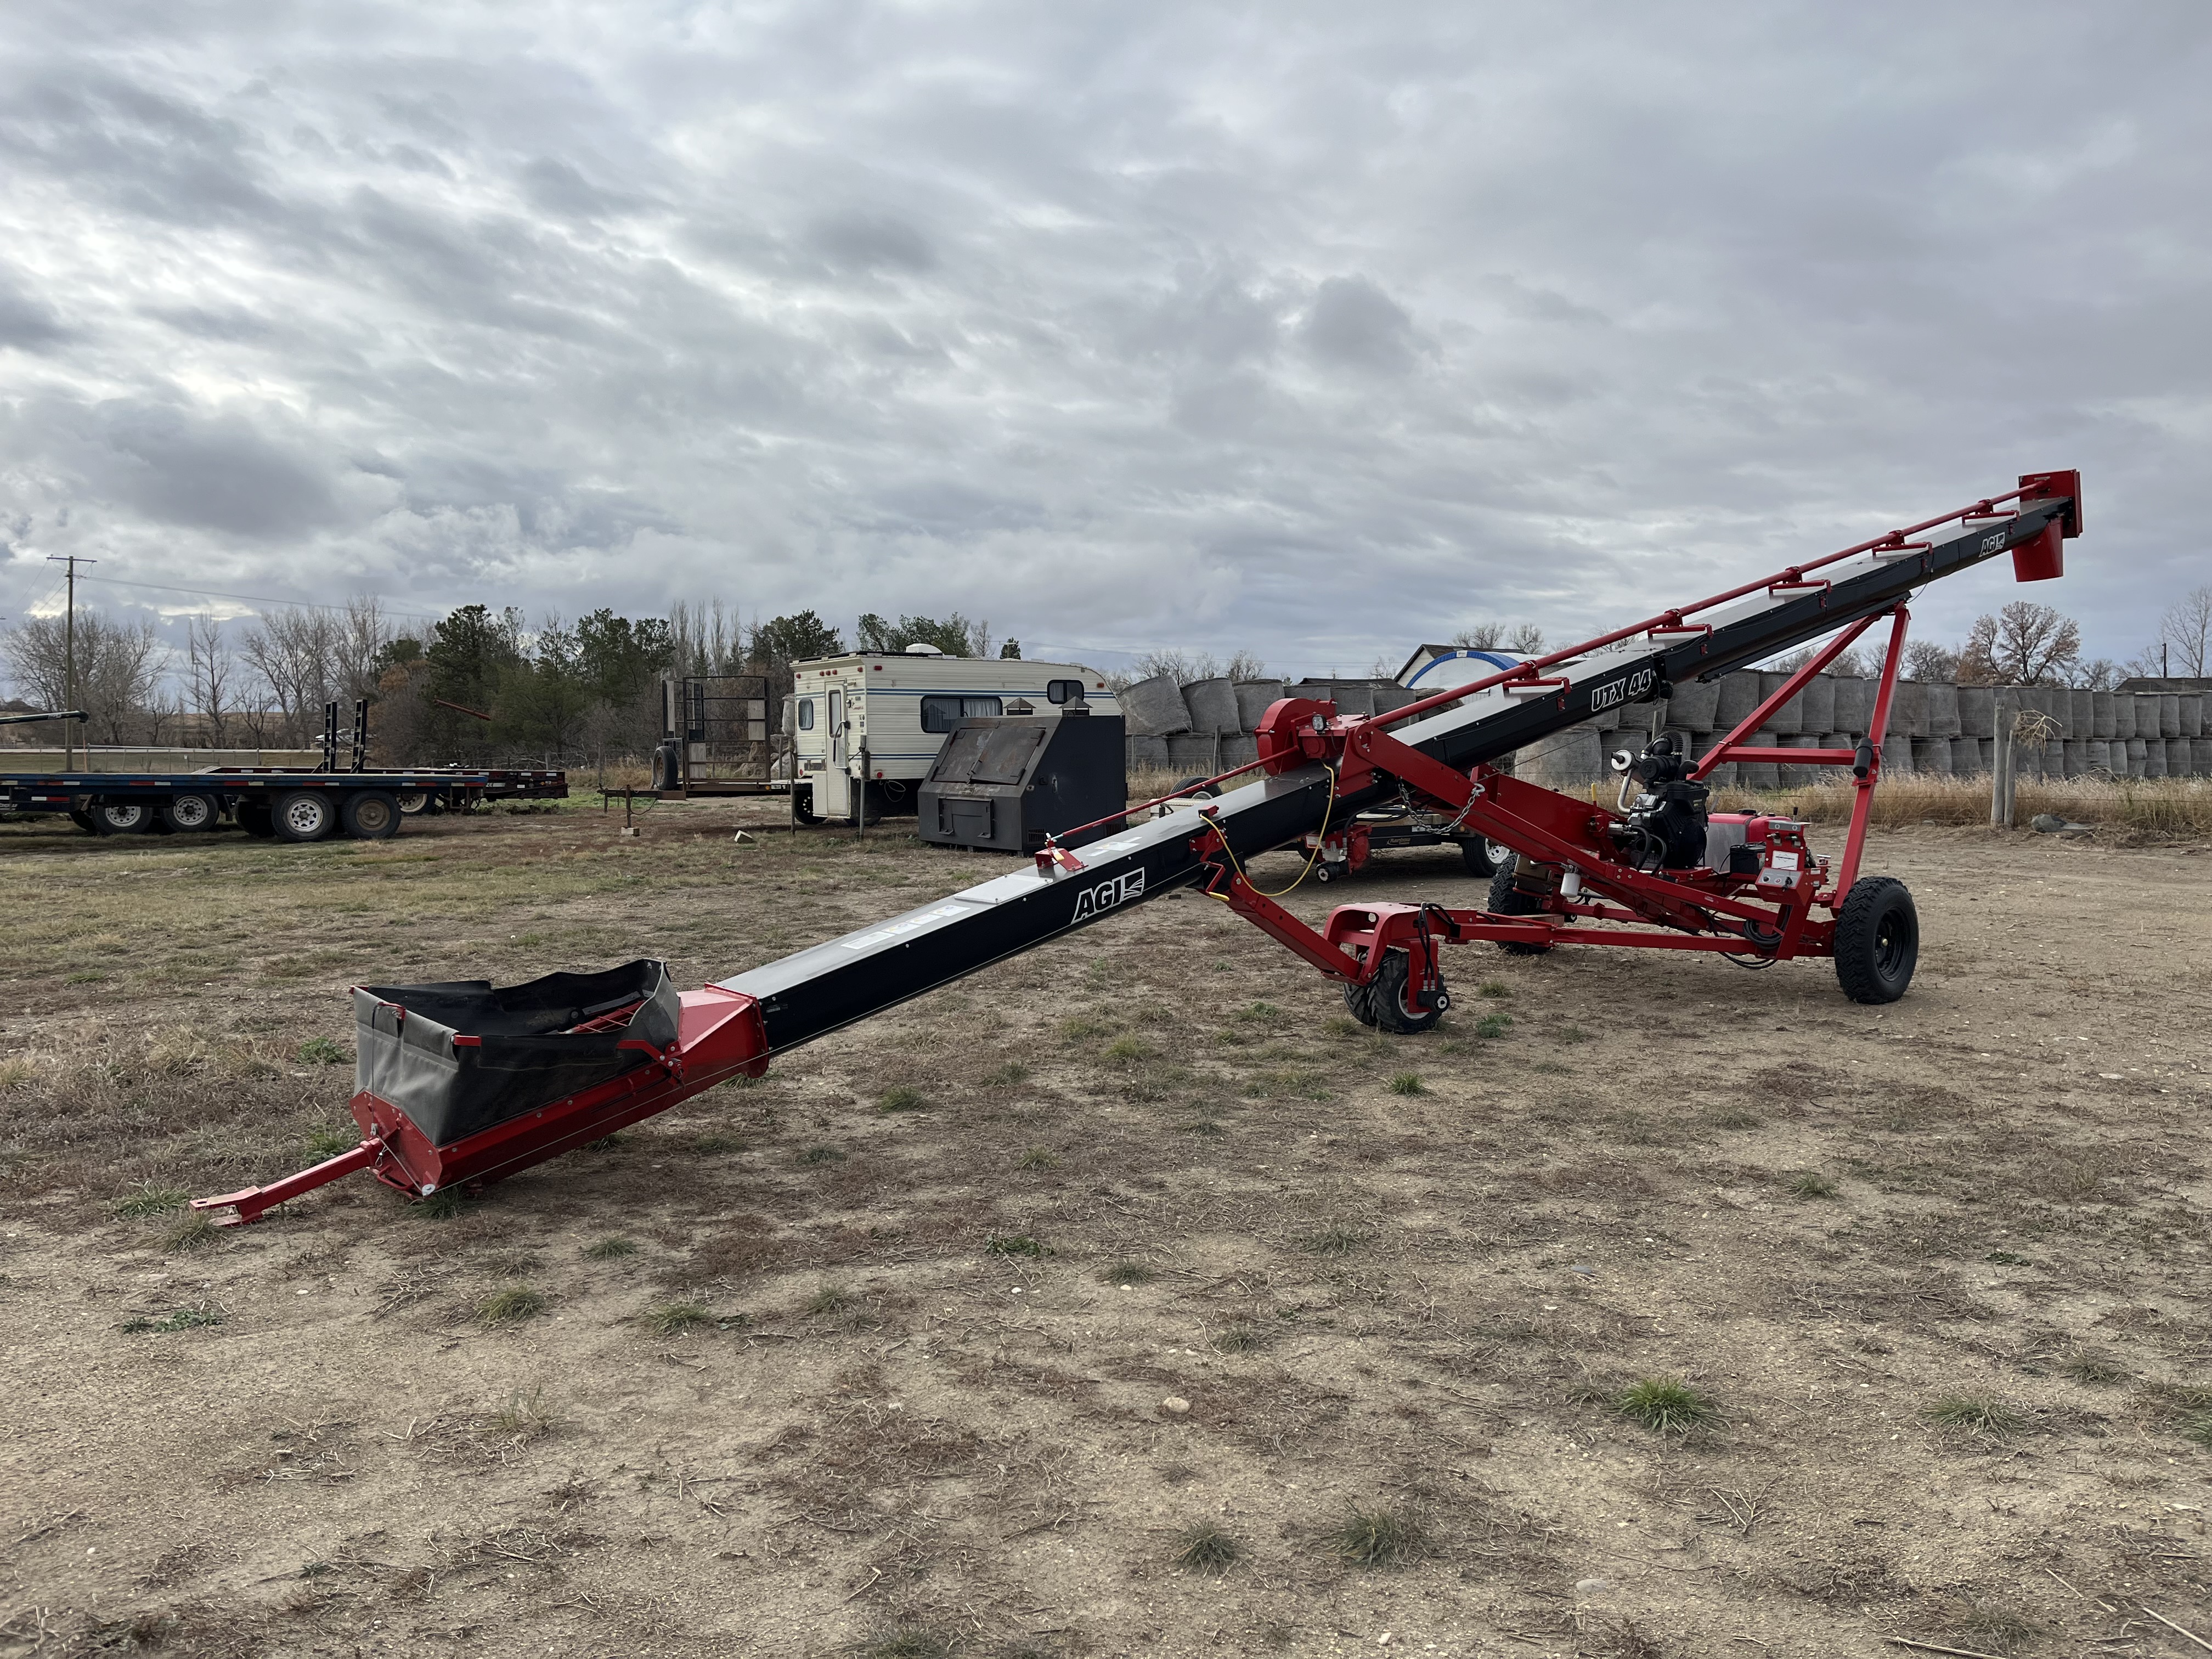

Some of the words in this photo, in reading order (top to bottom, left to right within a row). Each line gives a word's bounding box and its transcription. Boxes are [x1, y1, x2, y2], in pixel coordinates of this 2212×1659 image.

[1978, 535, 1997, 558] AGI
[1592, 678, 1626, 712] UTX
[1628, 668, 1651, 697] 44
[1071, 879, 1122, 924] AGI
